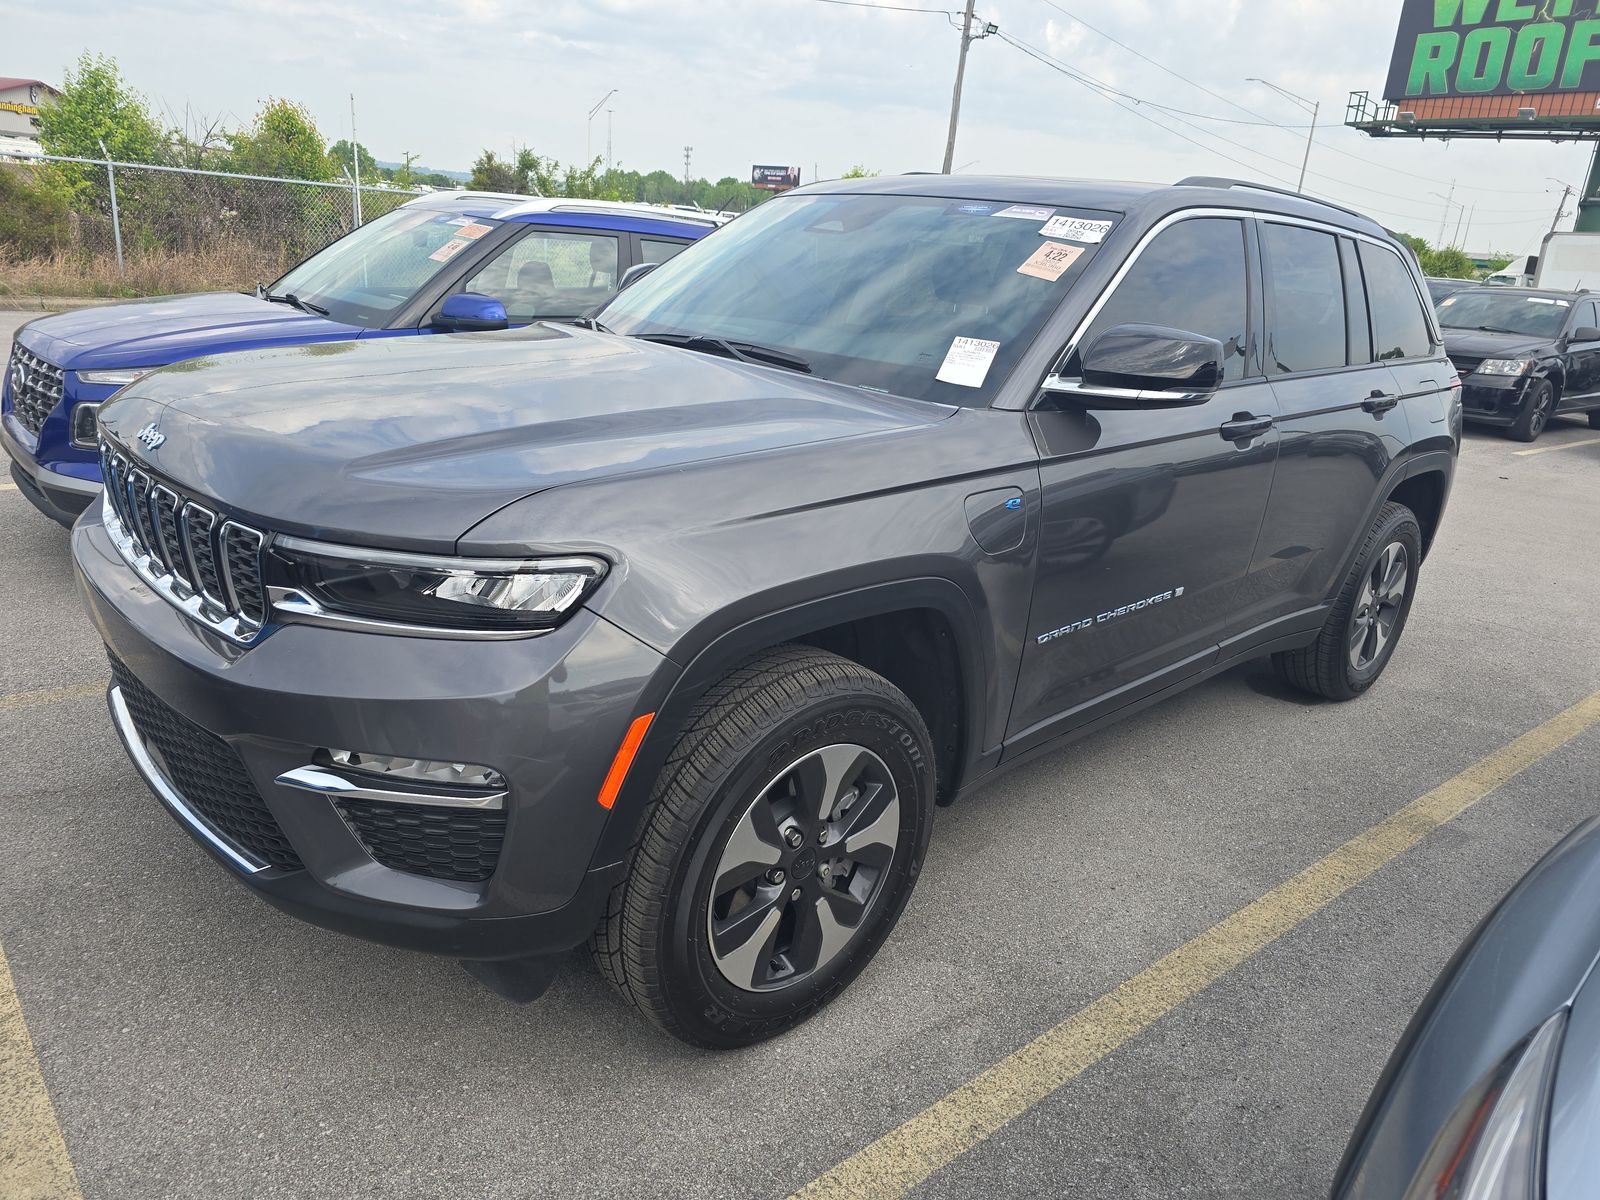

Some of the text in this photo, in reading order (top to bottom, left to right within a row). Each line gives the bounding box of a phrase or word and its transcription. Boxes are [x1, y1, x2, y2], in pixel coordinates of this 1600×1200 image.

[0, 101, 38, 115] nningham
[1052, 218, 1110, 233] 1413026
[958, 338, 999, 349] 1413026
[136, 422, 166, 450] Jeep
[1036, 590, 1173, 644] GRAND CHEROKEE
